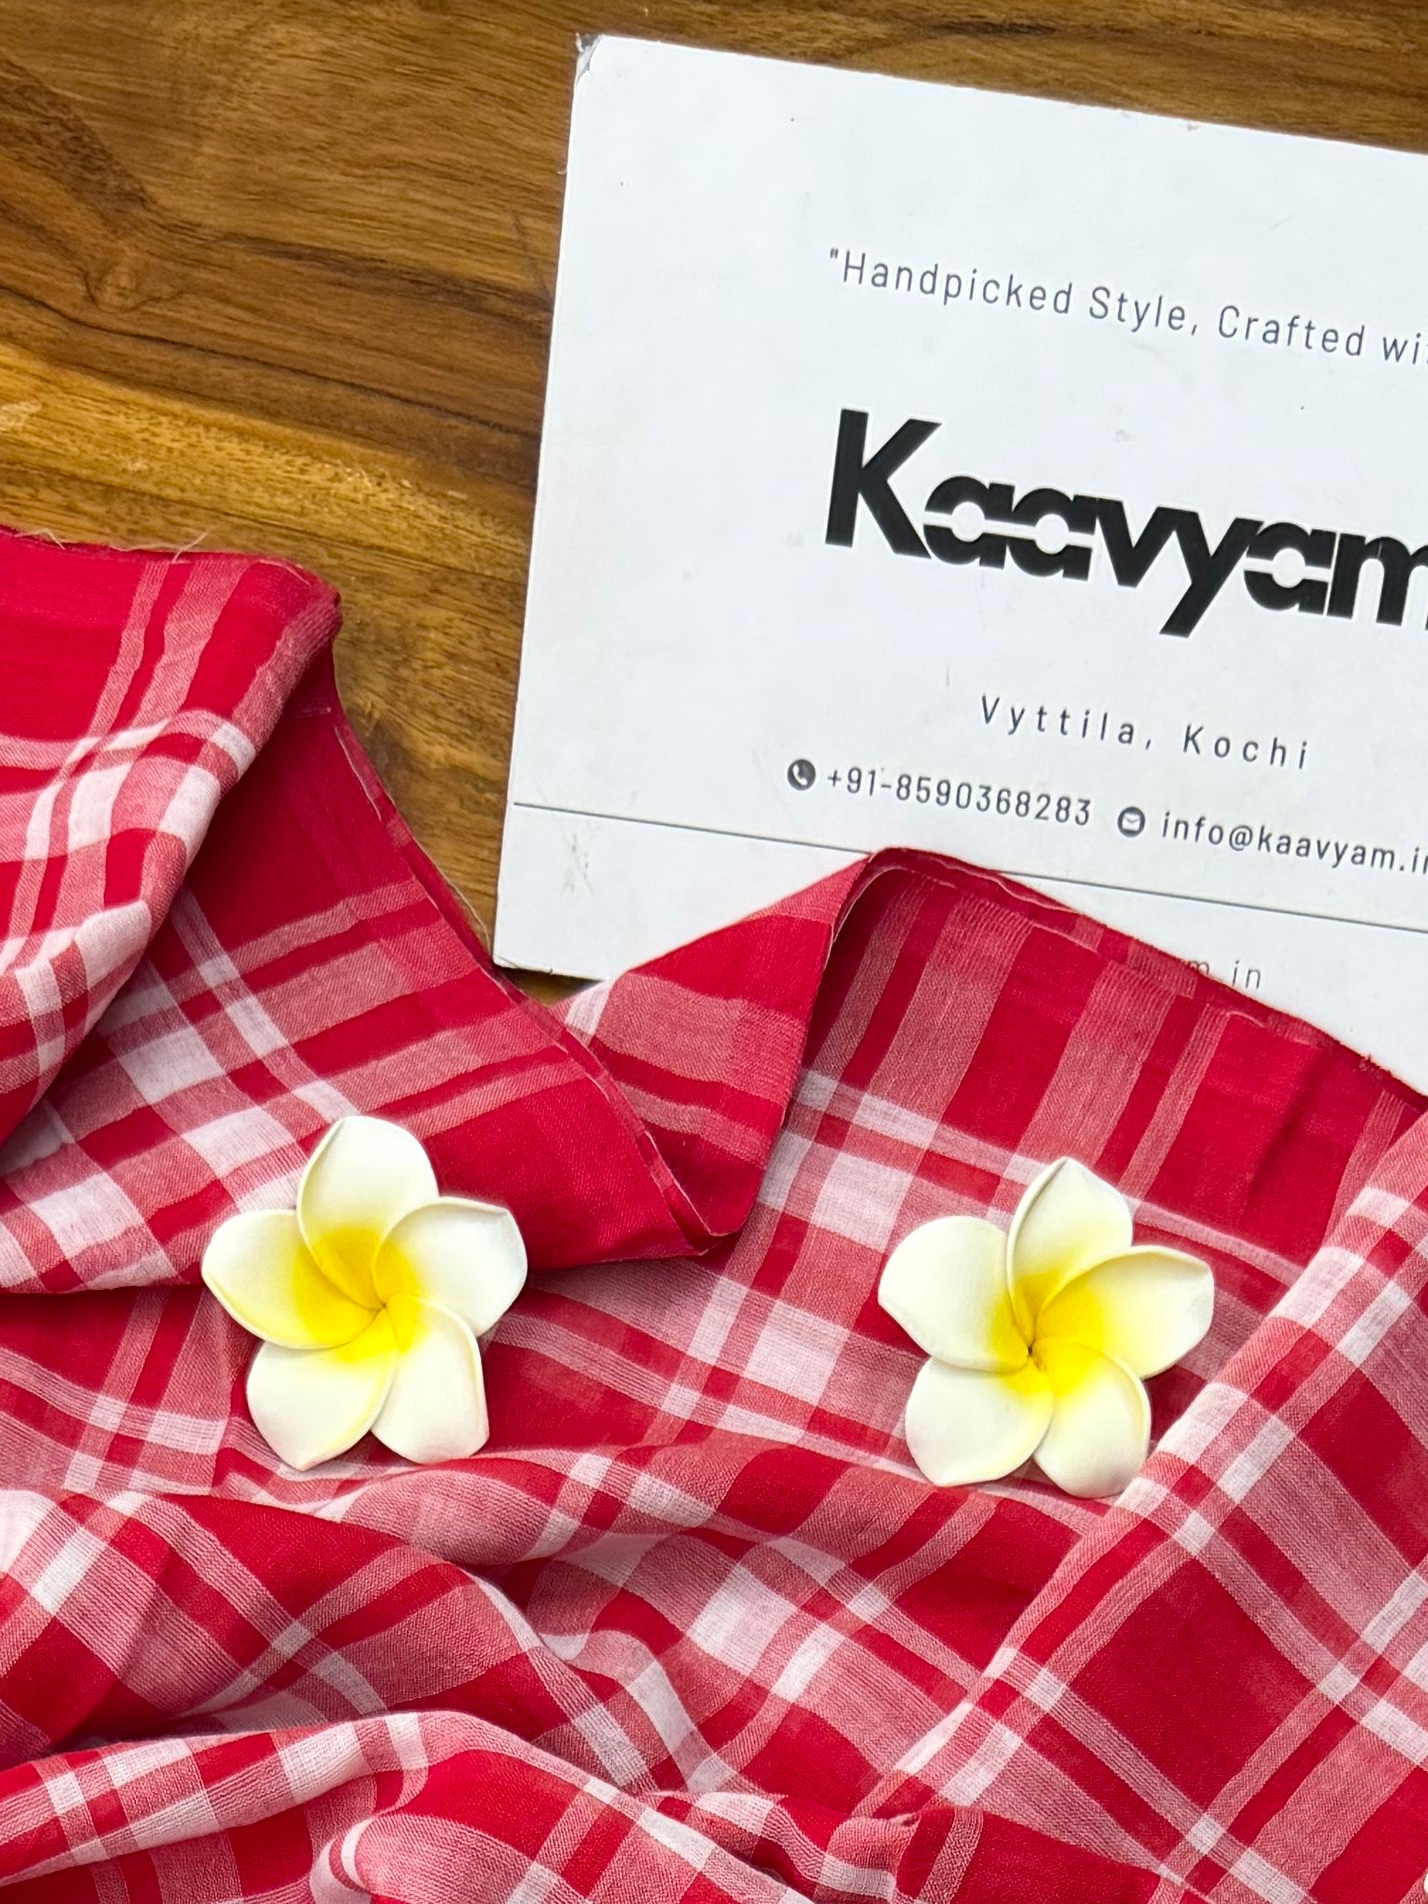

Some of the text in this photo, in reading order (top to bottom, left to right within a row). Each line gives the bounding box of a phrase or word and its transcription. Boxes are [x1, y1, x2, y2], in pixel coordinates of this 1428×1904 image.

[830, 248, 1072, 314] "Handpicked
[1089, 286, 1197, 336] Style,
[1219, 305, 1365, 356] Crafted
[982, 694, 1307, 769] Vyttila, Kochi
[827, 766, 1091, 826] +91-8590368283
